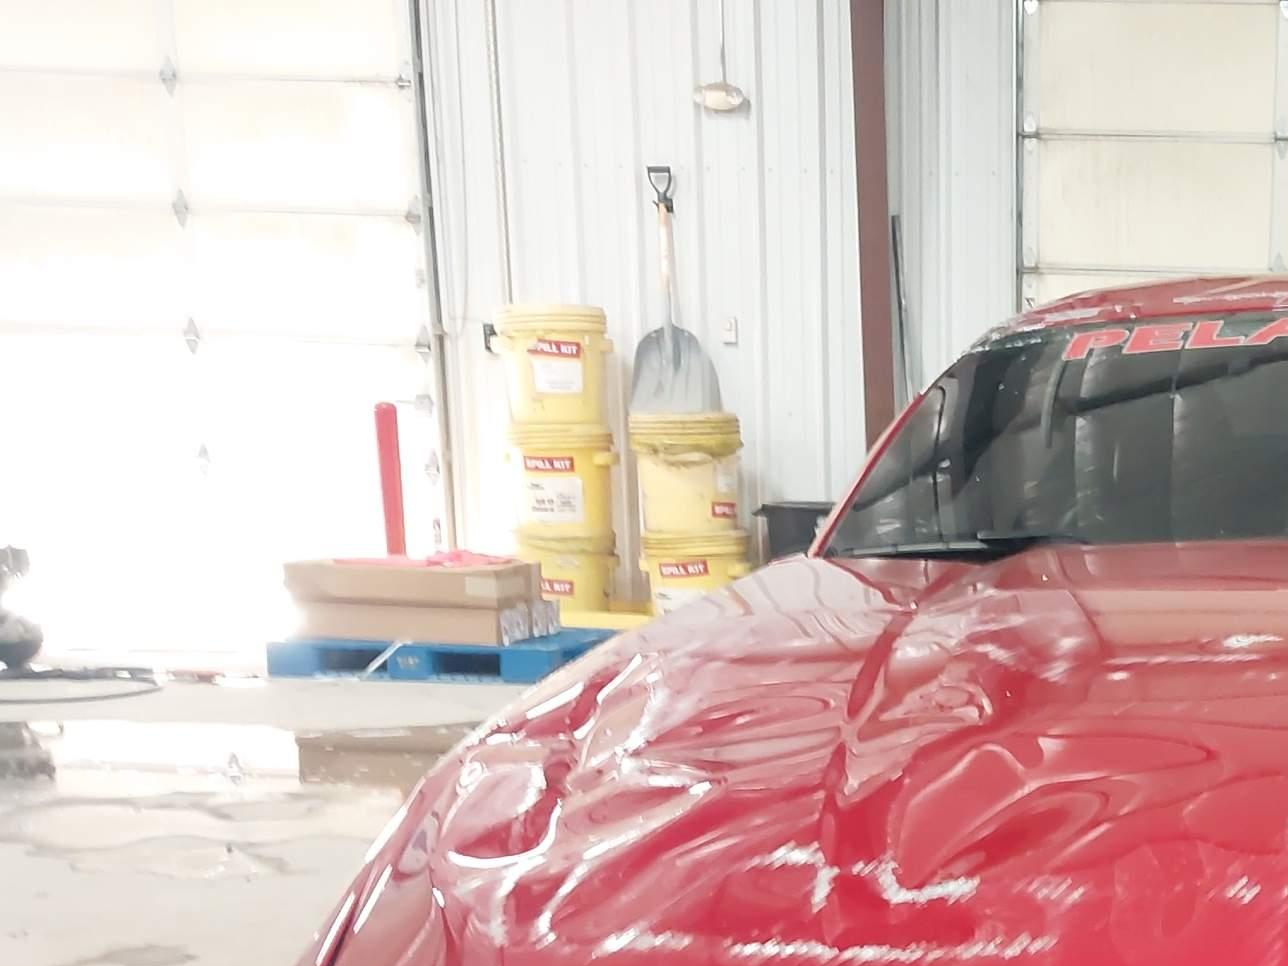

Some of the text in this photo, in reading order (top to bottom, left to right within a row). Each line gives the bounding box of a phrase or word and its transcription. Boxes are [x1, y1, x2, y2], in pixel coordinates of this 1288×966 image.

[560, 342, 577, 354] KIT
[525, 458, 571, 470] SPILL KIT
[661, 563, 705, 576] SPILL KIT
[553, 581, 571, 593] KIT
